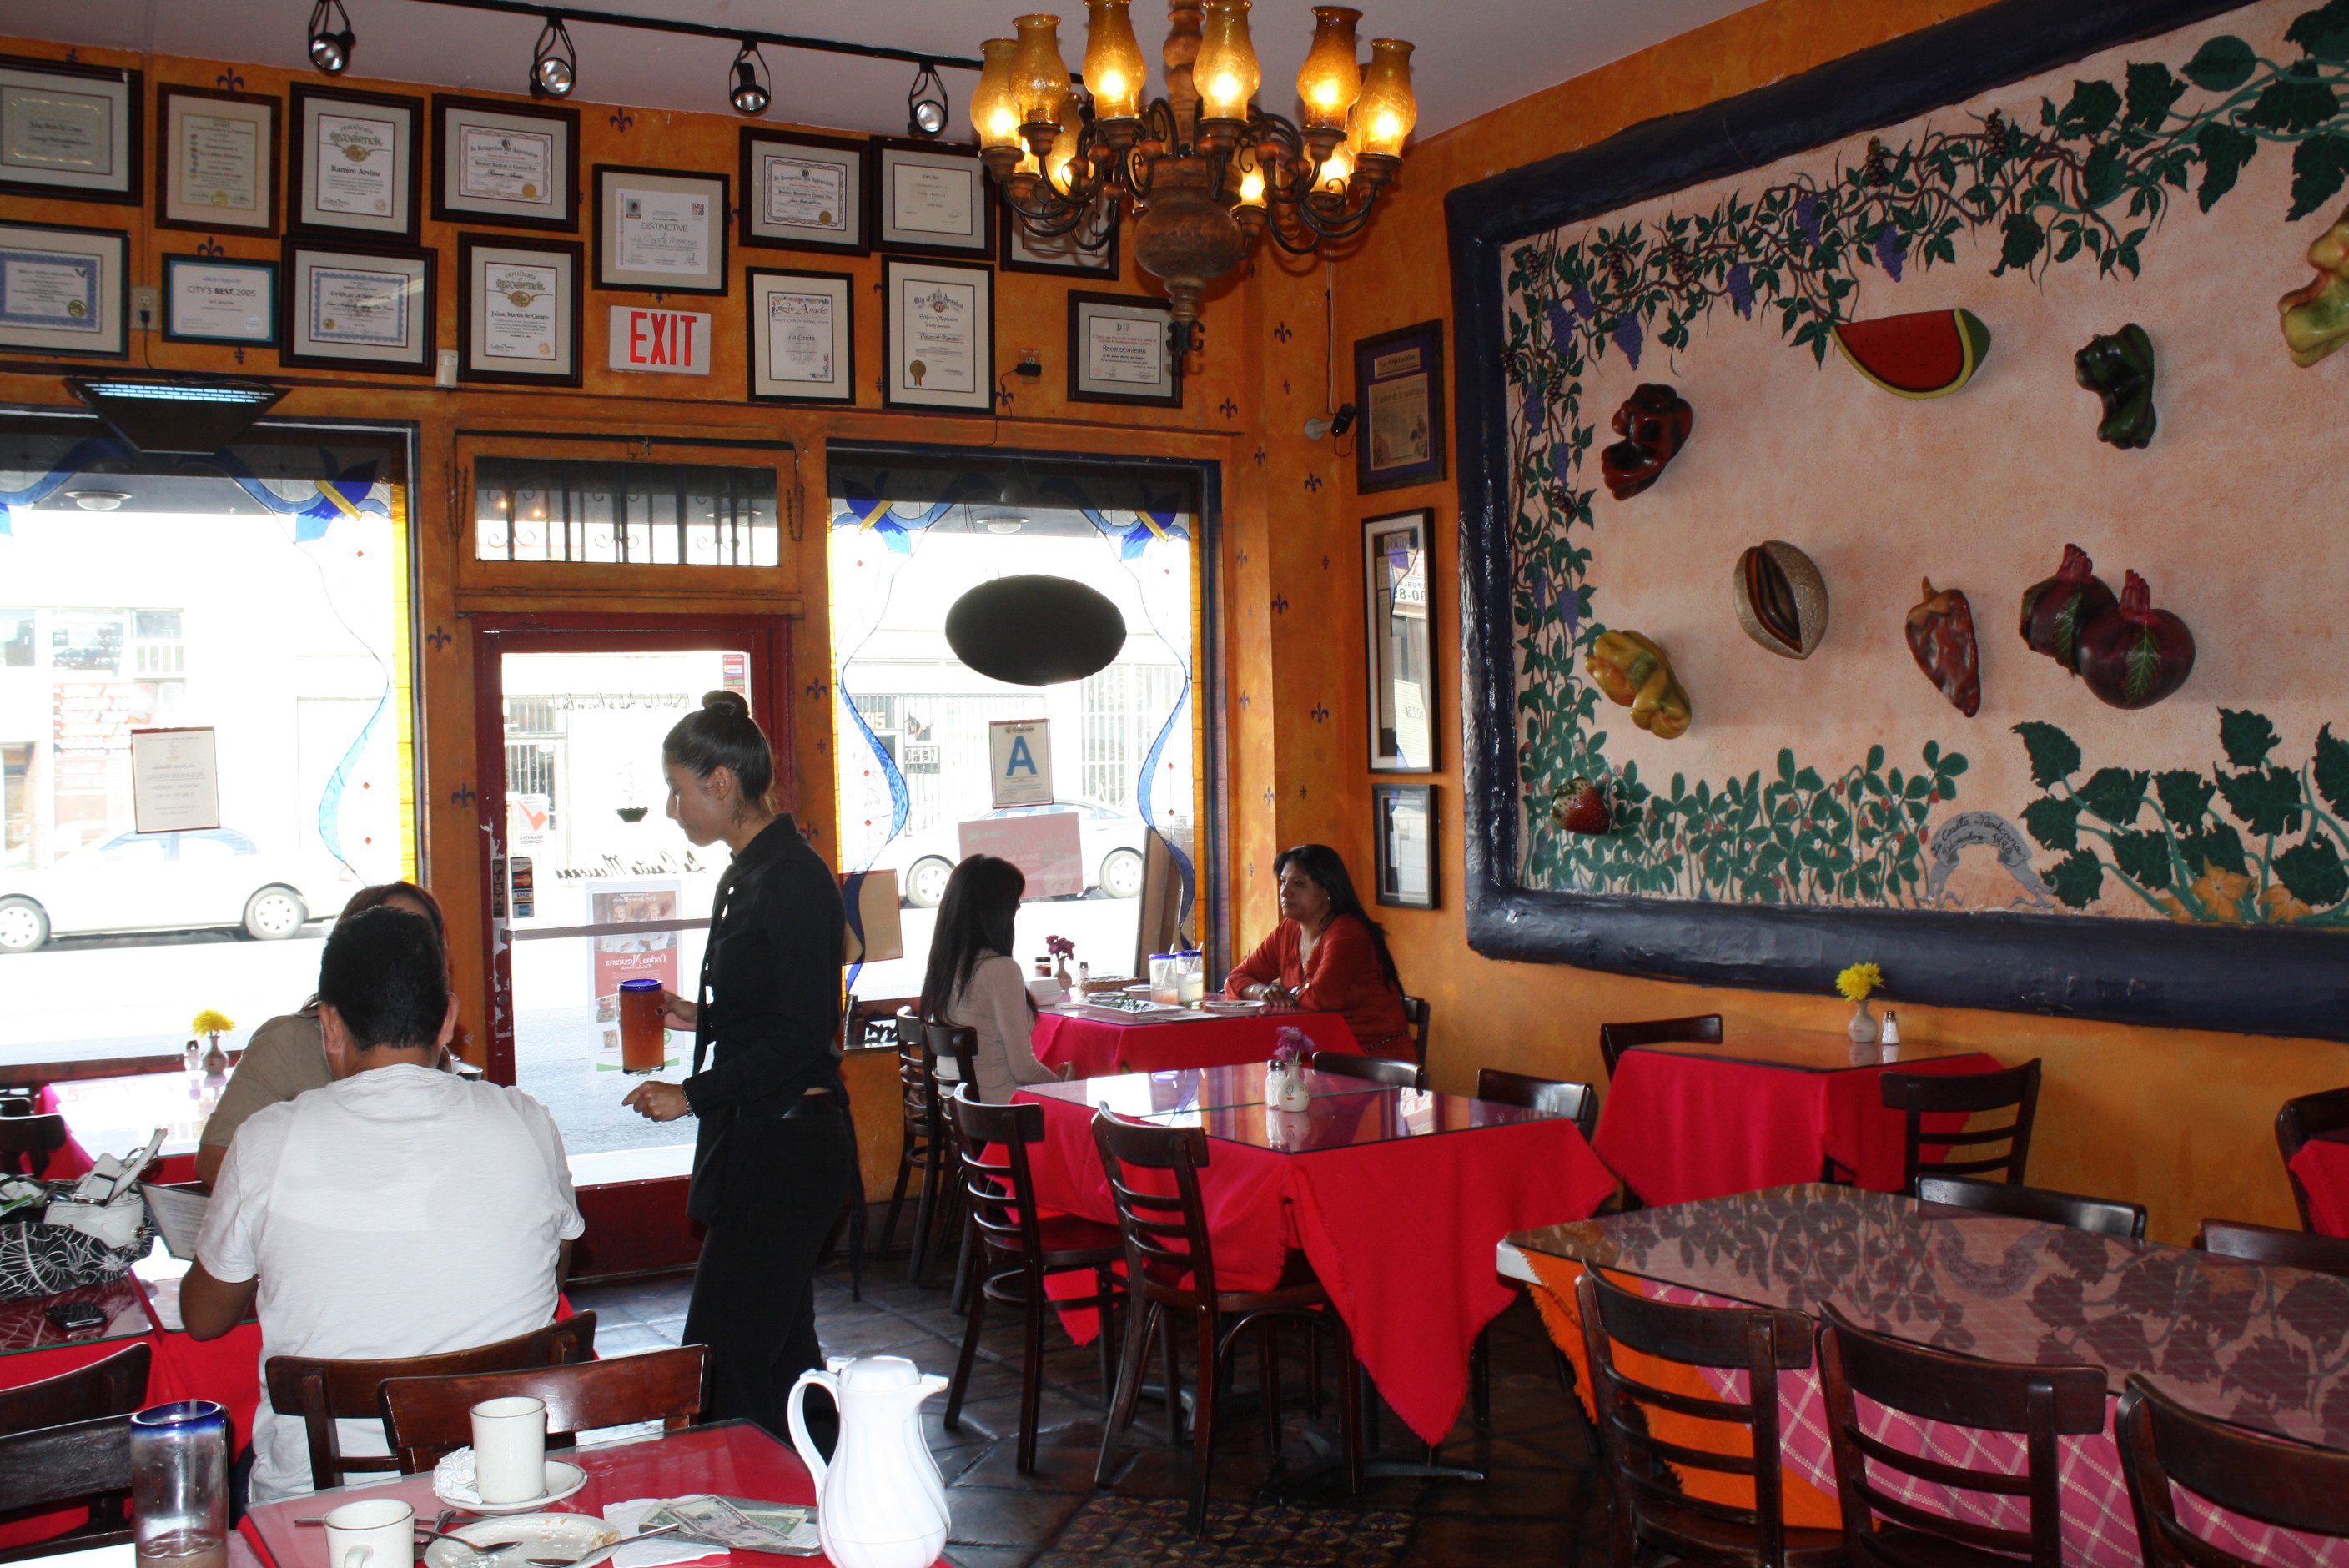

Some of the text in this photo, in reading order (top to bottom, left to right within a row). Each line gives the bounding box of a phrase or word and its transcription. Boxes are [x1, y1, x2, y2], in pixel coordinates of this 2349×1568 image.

[641, 222, 688, 233] DISTINCTIVE
[188, 285, 212, 294] CITY'S
[237, 289, 256, 297] 2005
[630, 311, 697, 367] EXIT
[1103, 344, 1147, 354] Reconocimiento
[1005, 736, 1039, 777] A
[1942, 816, 1970, 842] Casita
[1974, 814, 2025, 857] Mexicana
[494, 863, 505, 905] PUSH
